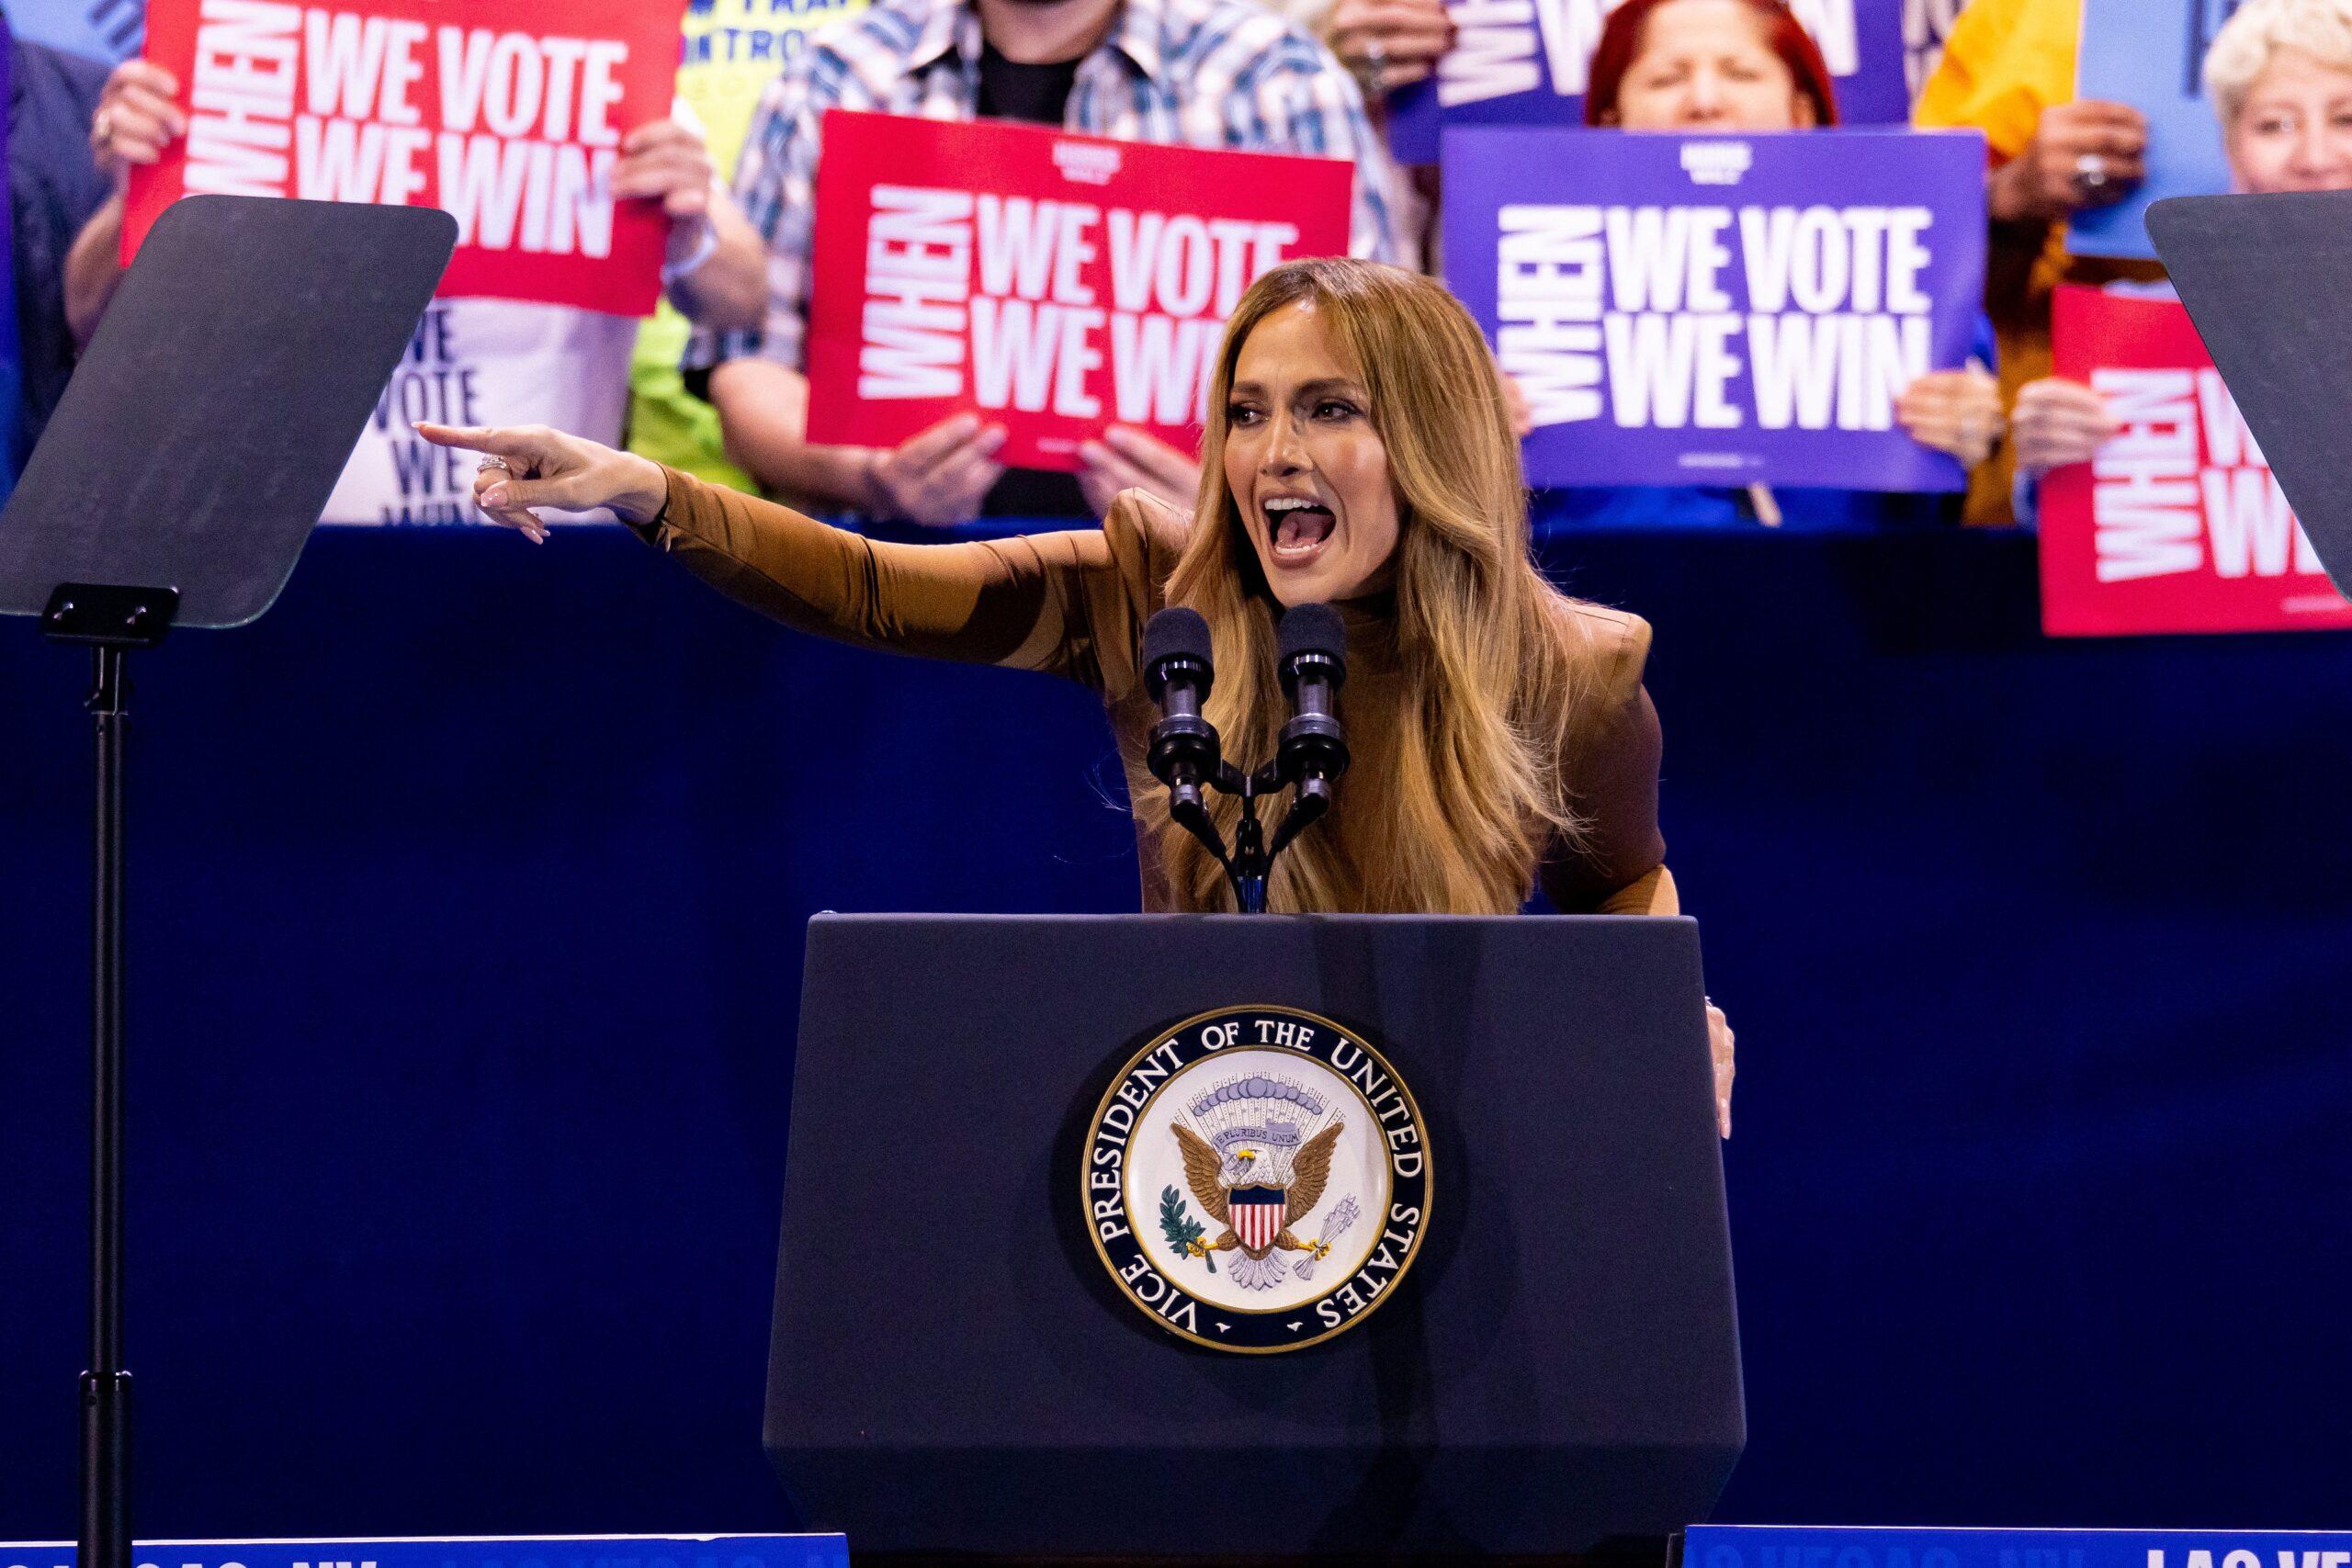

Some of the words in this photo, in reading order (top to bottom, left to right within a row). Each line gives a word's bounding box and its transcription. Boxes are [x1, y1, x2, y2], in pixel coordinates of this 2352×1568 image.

[184, 0, 300, 198] WHEN
[304, 8, 428, 126] WE
[436, 26, 628, 147] VOTE
[295, 114, 433, 205] WE
[437, 131, 616, 259] WIN
[976, 193, 1099, 305] WE
[857, 183, 972, 400] WHEN
[1498, 204, 1604, 428] WHEN
[1604, 205, 1734, 314] WE
[1739, 205, 1933, 315] VOTE
[969, 295, 1104, 419] WE
[1603, 312, 1745, 430] WE
[1746, 312, 1931, 433] WIN
[390, 440, 463, 495] WE
[2090, 367, 2204, 584] WHEN
[1200, 1021, 1241, 1051] OF
[1254, 1019, 1316, 1052] THE
[1090, 1038, 1187, 1244] PRESIDENT
[1223, 1127, 1269, 1140] PLURIBUS
[1272, 1132, 1300, 1144] UNUM
[1329, 1037, 1423, 1179] UNITED
[1119, 1253, 1198, 1335] VICE
[1315, 1201, 1420, 1329] STATES
